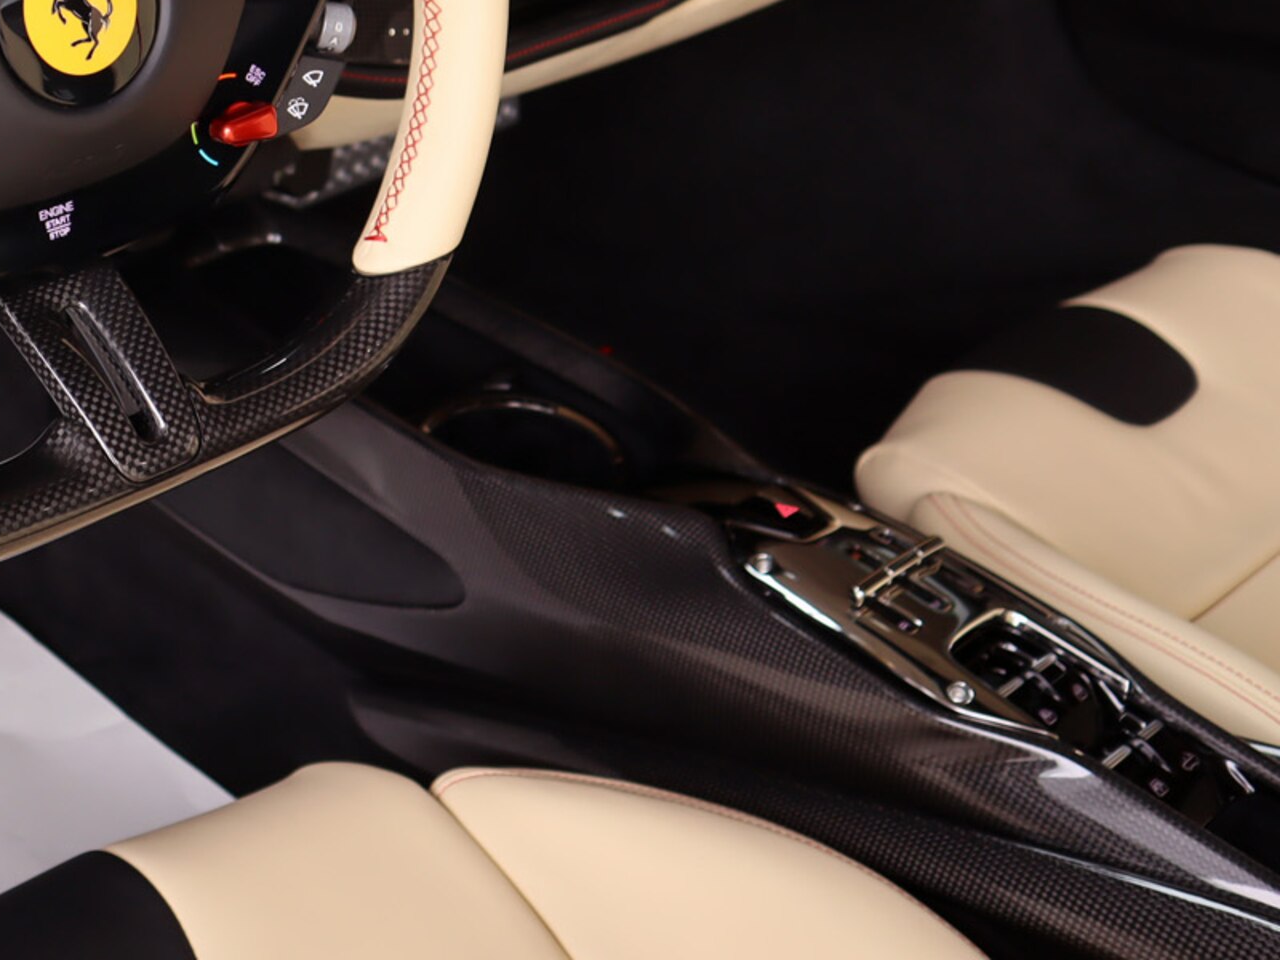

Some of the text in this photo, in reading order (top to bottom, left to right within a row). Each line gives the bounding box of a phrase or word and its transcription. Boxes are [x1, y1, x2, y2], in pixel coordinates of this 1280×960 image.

[38, 199, 75, 222] ENGINE
[45, 213, 72, 230] START
[49, 226, 72, 241] STOP
